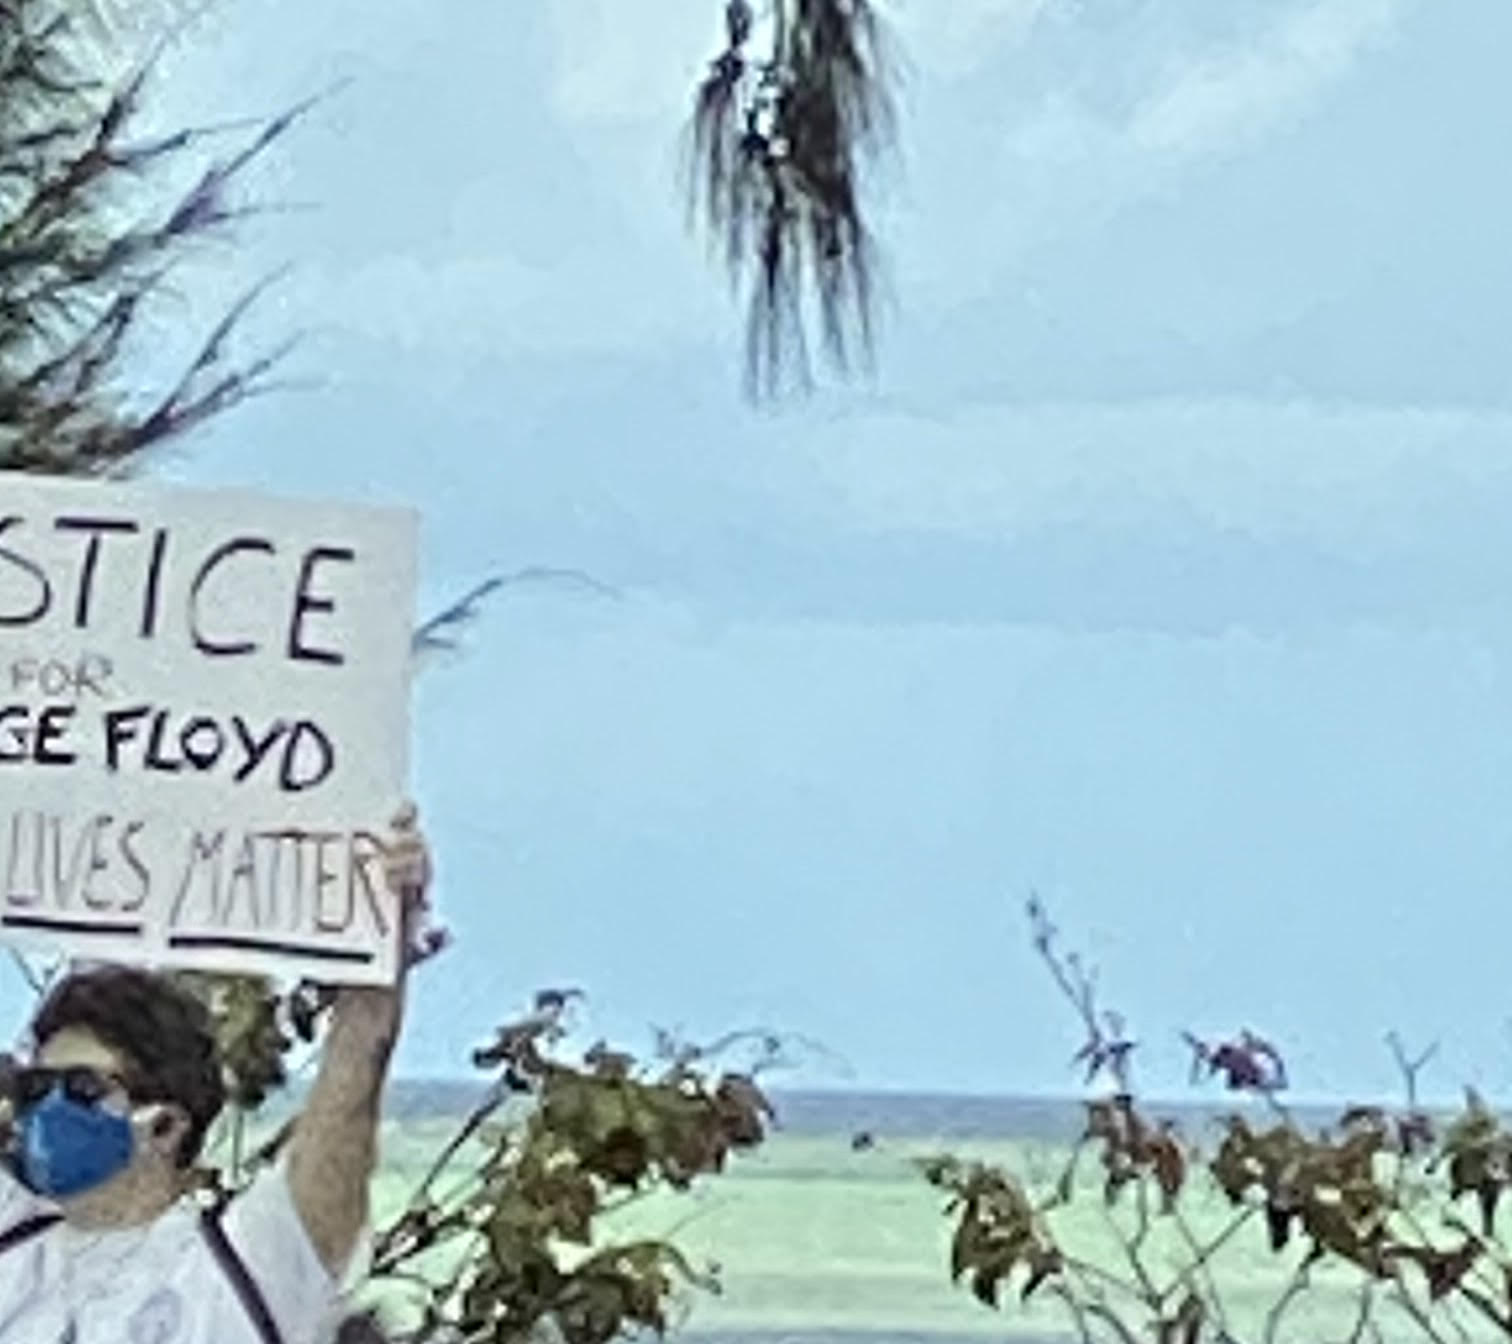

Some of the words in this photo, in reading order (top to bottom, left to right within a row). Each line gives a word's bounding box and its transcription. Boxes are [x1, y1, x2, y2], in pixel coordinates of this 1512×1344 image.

[9, 655, 114, 697] FOR
[102, 706, 336, 793] FLOYD
[6, 809, 151, 912] LIVES
[168, 828, 390, 938] MATTER
